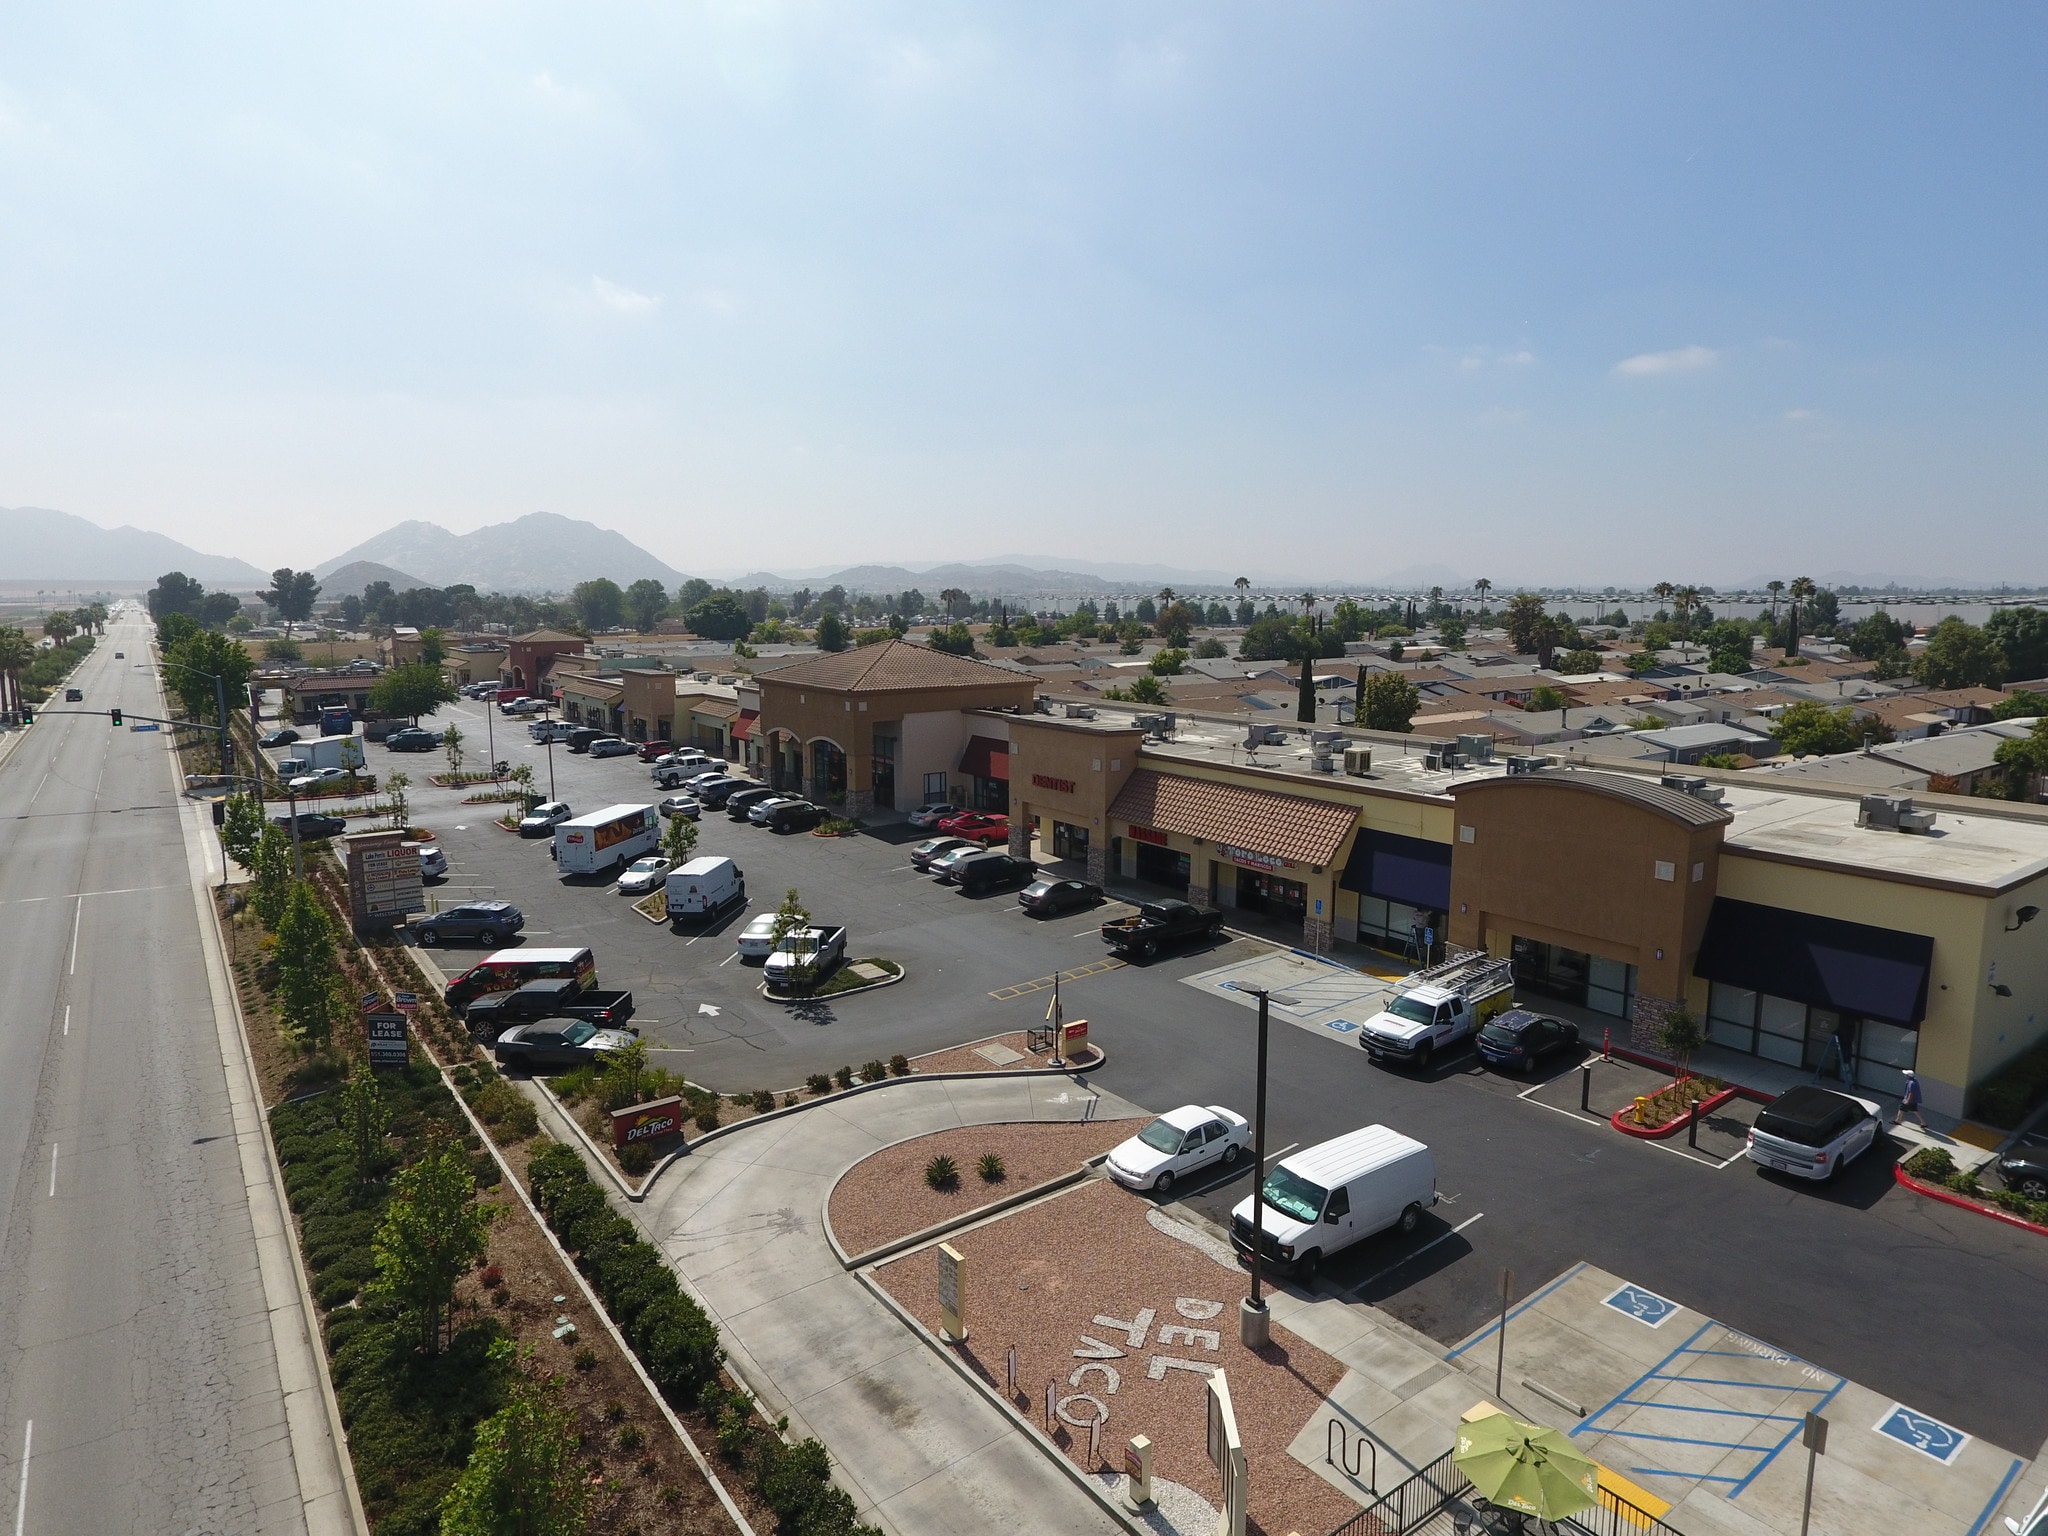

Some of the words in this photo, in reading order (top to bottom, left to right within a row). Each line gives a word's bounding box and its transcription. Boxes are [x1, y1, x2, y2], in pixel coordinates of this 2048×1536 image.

[1032, 774, 1076, 793] DENTIST
[387, 847, 417, 858] LIQUOR
[397, 995, 417, 1003] Brown
[377, 1022, 396, 1030] FOR
[372, 1030, 402, 1038] LEASE
[627, 1128, 649, 1141] DEL
[649, 1118, 673, 1134] TACO
[1147, 1297, 1225, 1381] DEL
[1725, 1332, 1791, 1367] PARKING
[1056, 1307, 1157, 1428] TACO
[1801, 1367, 1825, 1382] NO
[1507, 1499, 1521, 1509] DEL
[1520, 1501, 1537, 1511] TACO
